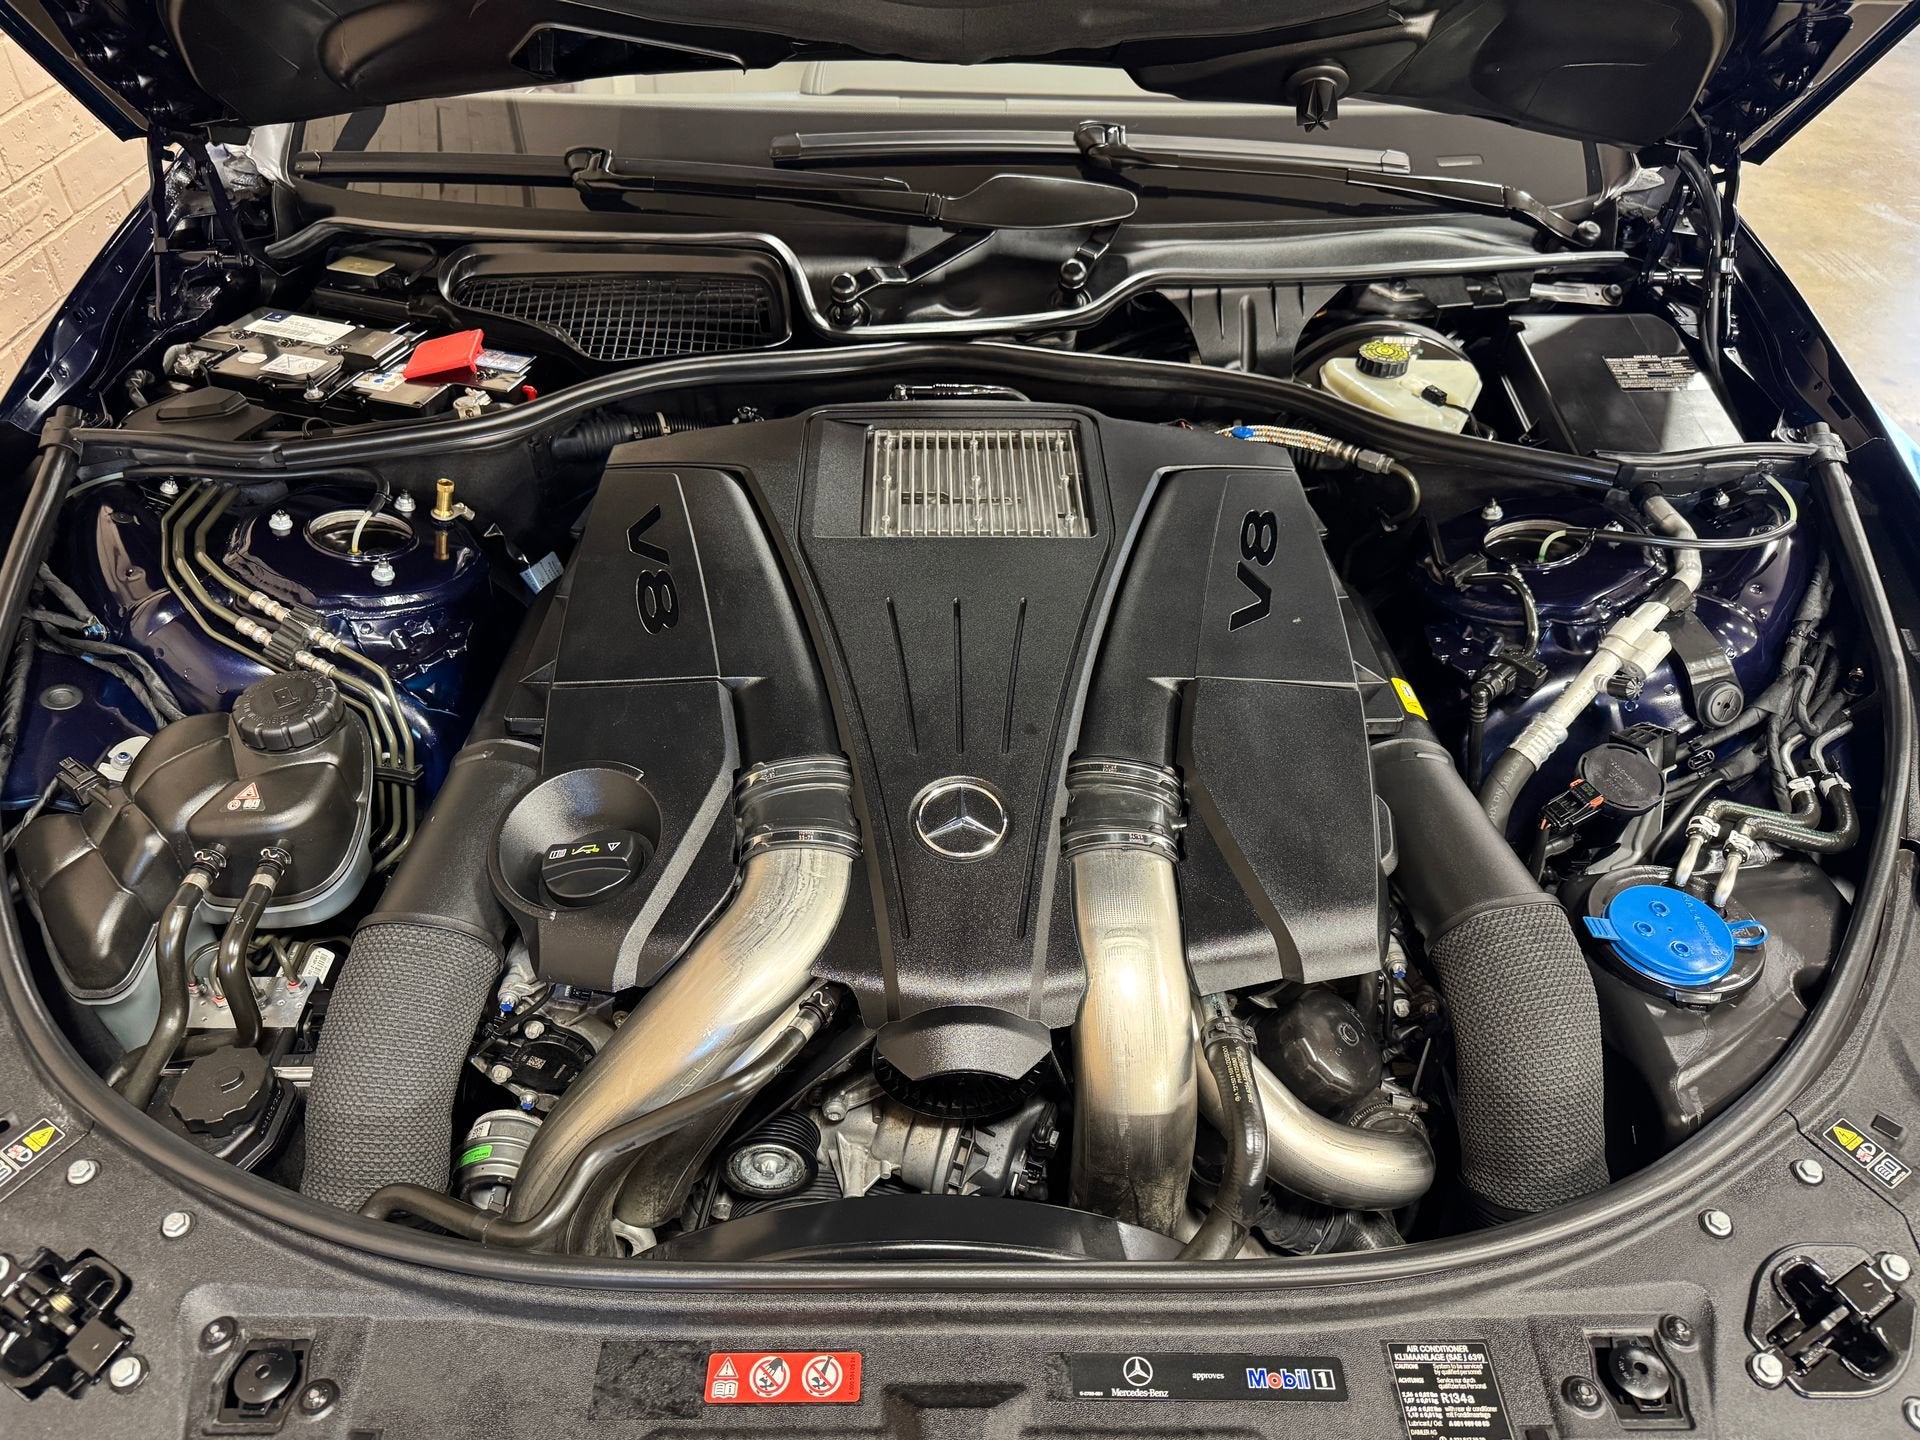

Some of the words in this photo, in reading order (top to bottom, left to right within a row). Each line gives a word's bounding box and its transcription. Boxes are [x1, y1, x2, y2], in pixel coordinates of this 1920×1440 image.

[627, 503, 680, 635] V8
[1228, 509, 1278, 632] V8
[1406, 1345, 1419, 1353] AIR
[1419, 1345, 1469, 1353] CONDITIONER
[1394, 1353, 1446, 1361] KLIMAANLAGE
[1446, 1353, 1463, 1363] (SAE
[1468, 1353, 1486, 1363] 639)
[1192, 1371, 1225, 1380] approves
[1246, 1368, 1311, 1389] Mobil
[1111, 1388, 1169, 1398] Mercedes-Benz
[1440, 1392, 1475, 1404] R134a
